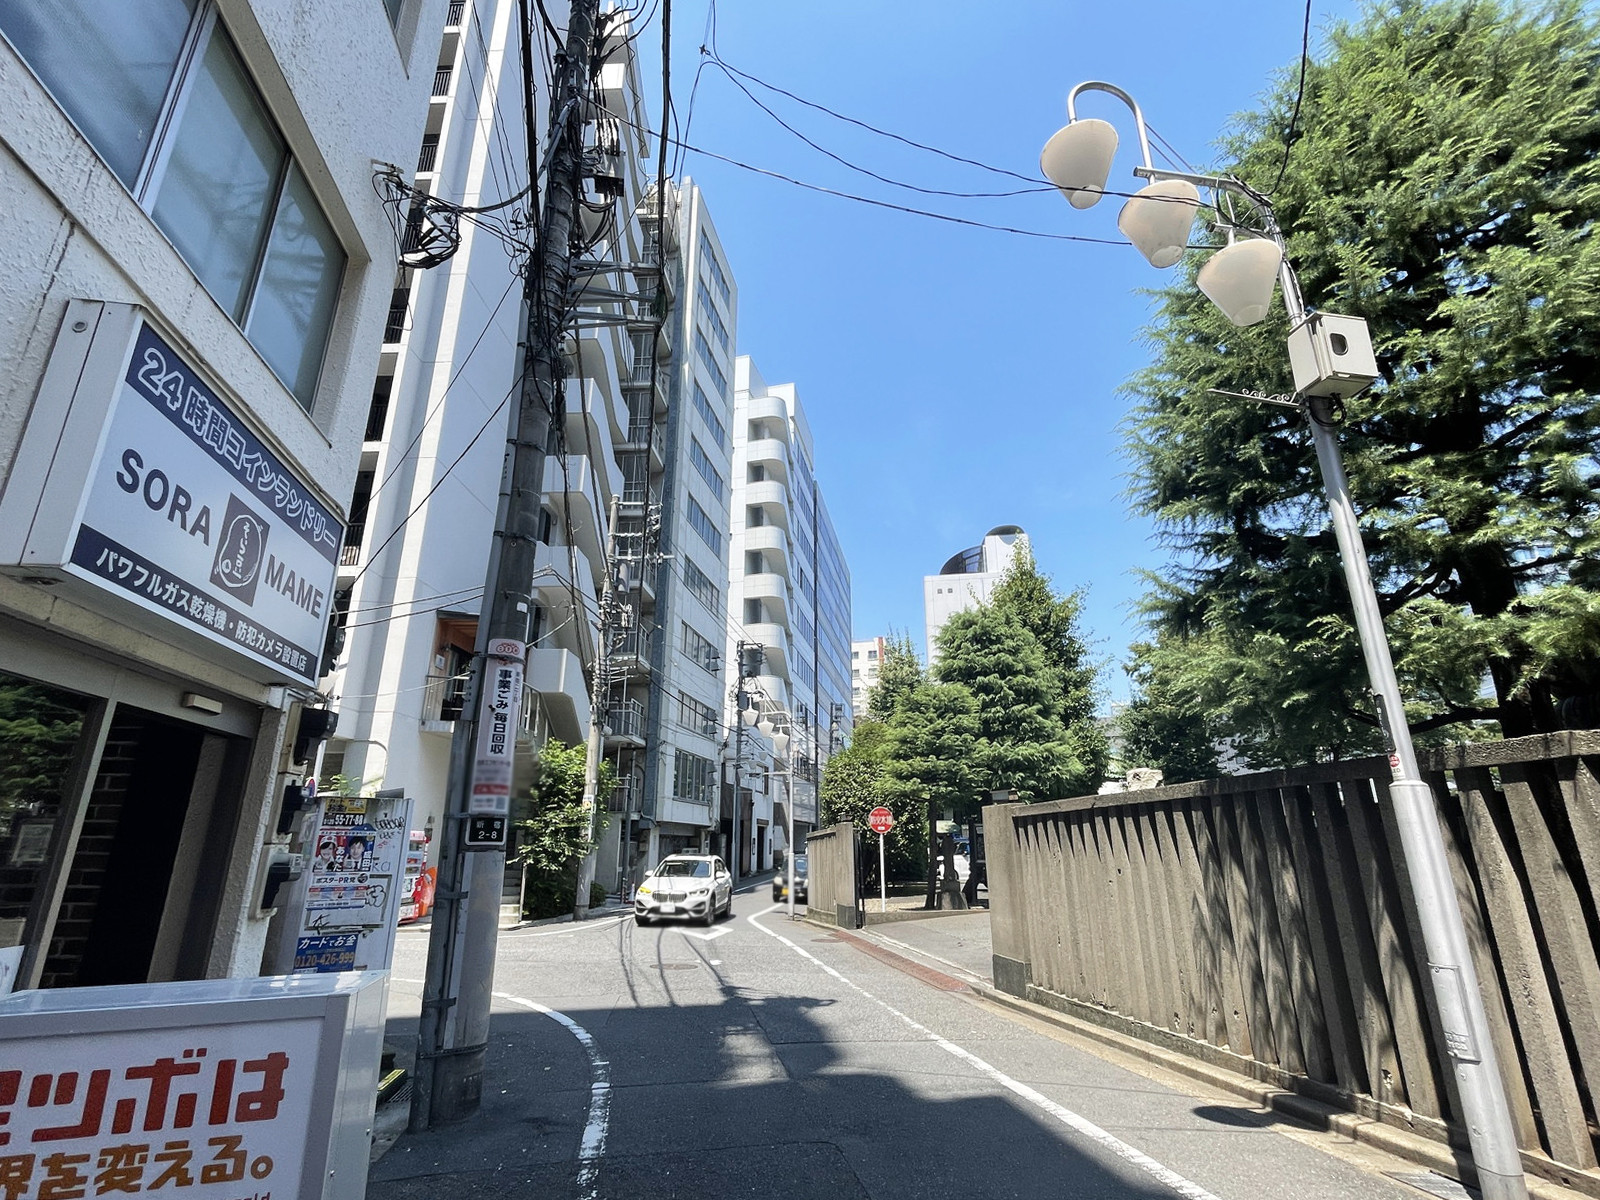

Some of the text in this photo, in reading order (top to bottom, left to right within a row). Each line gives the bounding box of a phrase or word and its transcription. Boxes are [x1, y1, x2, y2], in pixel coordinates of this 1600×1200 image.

[138, 347, 337, 549] 24時間コインランドリー
[116, 448, 210, 547] SORA
[96, 547, 307, 673] パワフルガス乾燥機・防犯カメラ設置店
[264, 553, 324, 620] MAME
[489, 712, 508, 755] 毎日回収
[478, 830, 497, 840] 2-8
[295, 952, 355, 967] 0120-426-999
[299, 935, 356, 949] カードでお金
